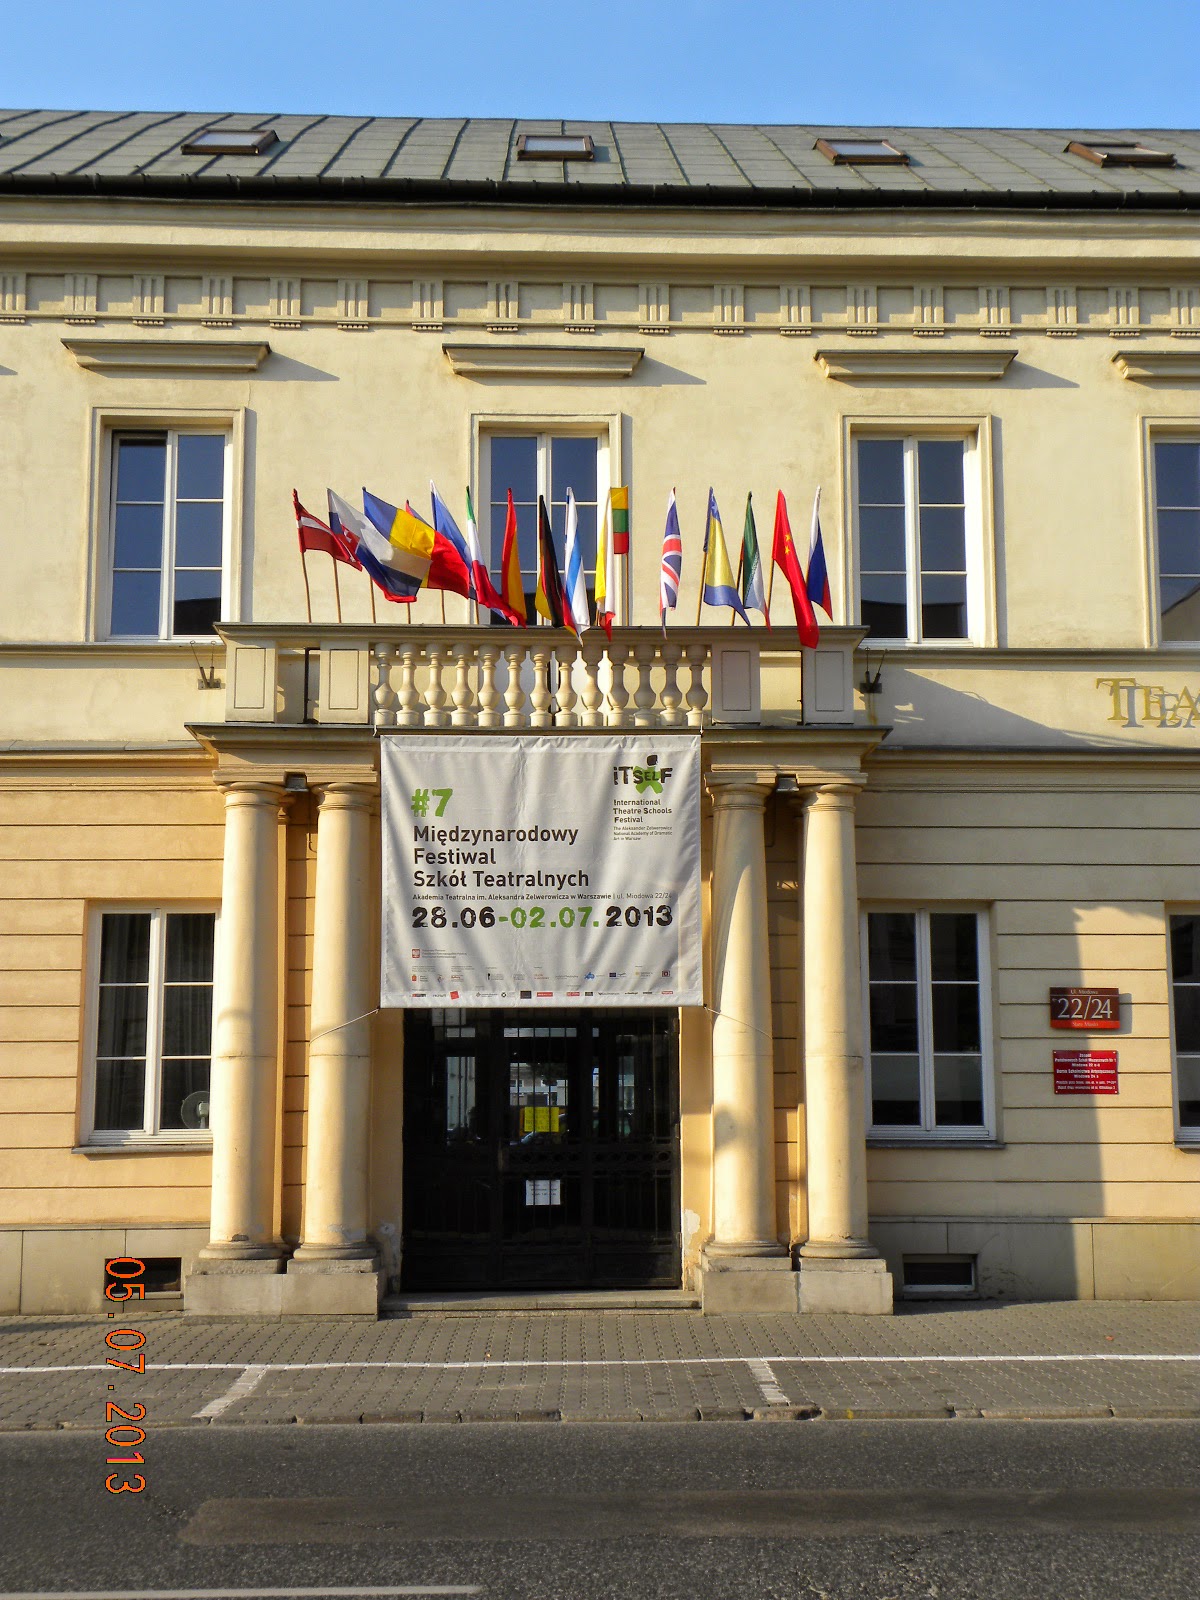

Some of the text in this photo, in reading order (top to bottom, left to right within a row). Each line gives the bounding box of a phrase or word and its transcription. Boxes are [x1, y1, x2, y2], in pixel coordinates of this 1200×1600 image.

[411, 788, 454, 818] #7
[413, 825, 579, 846] Międzynarodowy
[414, 848, 497, 865] Festiwal
[413, 870, 590, 890] Szkół Teatralnych
[1057, 996, 1113, 1020] 22/24
